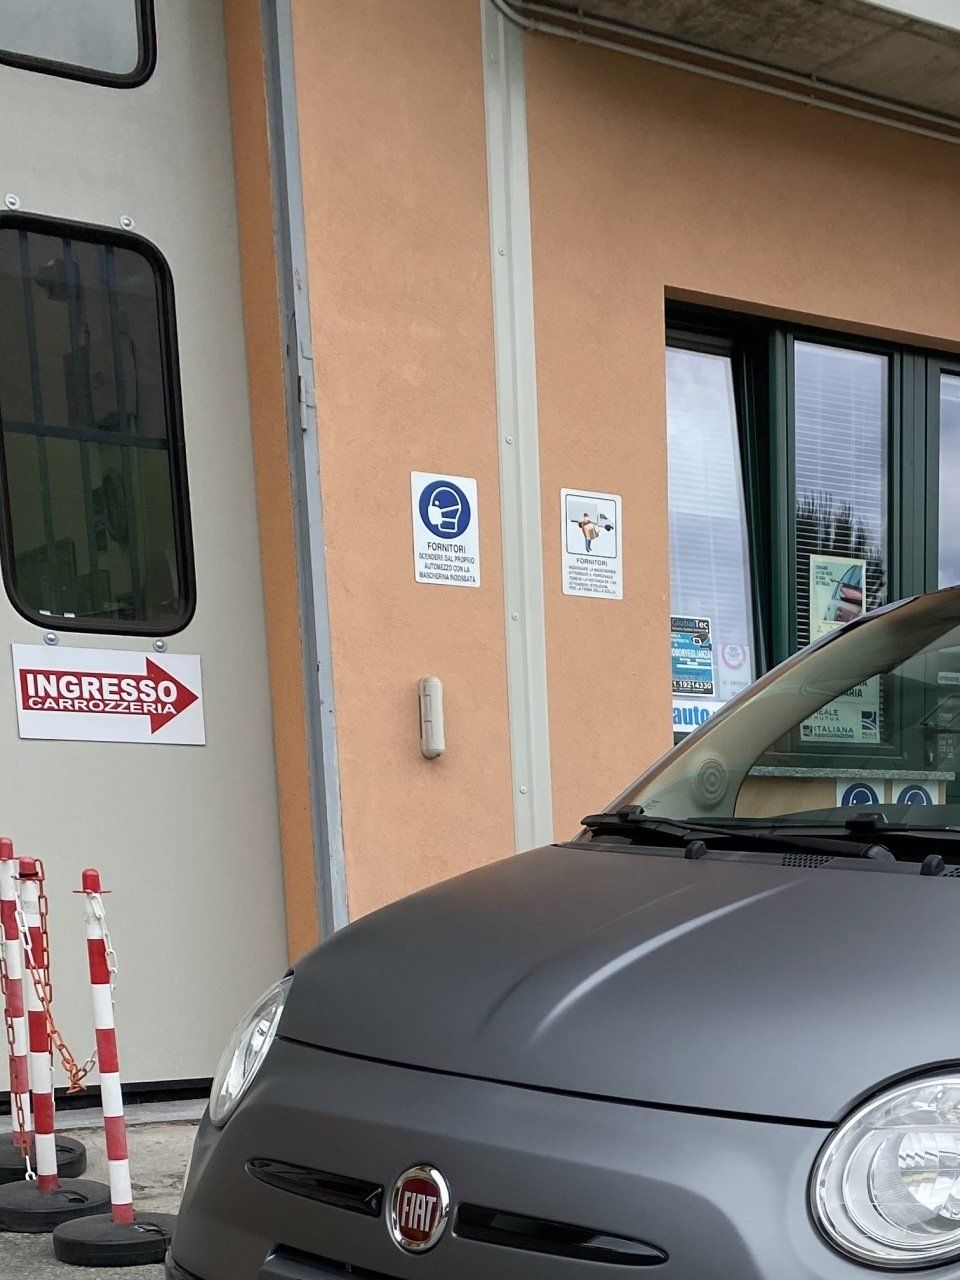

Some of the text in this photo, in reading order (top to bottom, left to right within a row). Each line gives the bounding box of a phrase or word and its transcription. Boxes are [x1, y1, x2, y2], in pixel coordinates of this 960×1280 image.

[427, 541, 466, 554] FORNITORI
[418, 552, 475, 565] SCENDERE DAL PROPRIO
[576, 557, 608, 567] FORNITORI
[424, 562, 453, 572] AUTOMEZZO
[453, 564, 463, 573] CON
[419, 570, 476, 583] MASCHERINA INDOSSATA
[26, 673, 178, 703] INGRESSO
[28, 697, 178, 715] CARROZZERIA
[672, 705, 710, 726] auto
[814, 725, 854, 734] ITALIANA
[401, 1191, 438, 1232] FIAT
